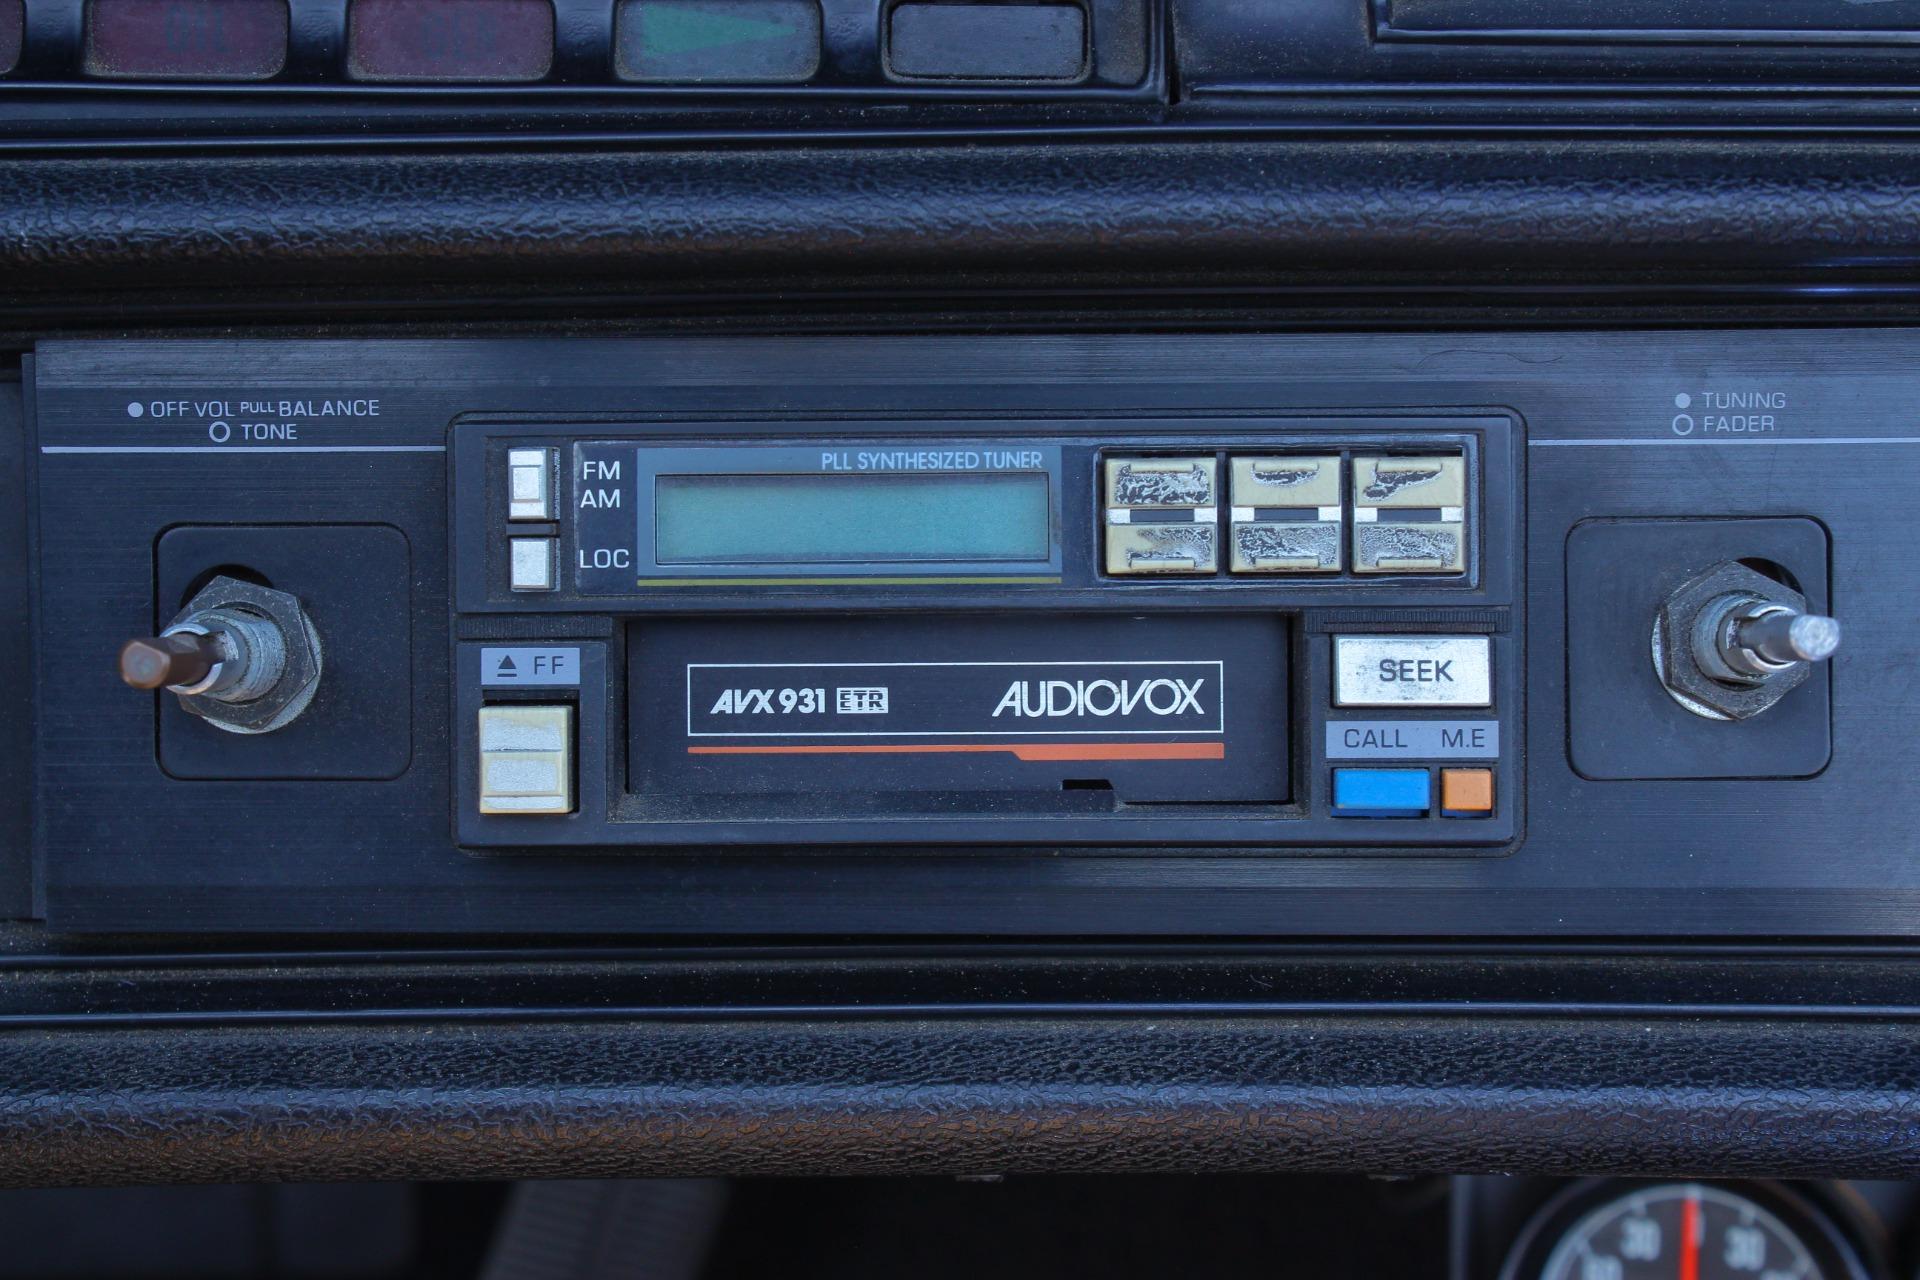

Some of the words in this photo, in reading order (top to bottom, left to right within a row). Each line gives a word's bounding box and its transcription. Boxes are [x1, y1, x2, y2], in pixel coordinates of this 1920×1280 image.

[151, 401, 189, 418] OFF
[194, 401, 235, 417] VOL
[240, 402, 275, 413] PULL
[279, 400, 379, 417] BALANCE
[1702, 392, 1786, 409] TUNING
[241, 423, 297, 440] TONE
[1704, 415, 1775, 432] FADER
[822, 452, 852, 470] PLL
[857, 452, 980, 470] SYNTHESIZED
[984, 451, 1043, 469] TUNER
[583, 461, 621, 480] FM
[580, 489, 621, 508] AM
[579, 549, 630, 569] LOC
[534, 655, 564, 675] FF
[1379, 659, 1454, 682] SEEK
[710, 688, 776, 714] AVX
[778, 687, 826, 714] 931
[838, 689, 886, 711] ETR
[991, 678, 1205, 718] AUDIOVOX
[1344, 728, 1408, 748] CALL
[1441, 728, 1485, 748] M.E
